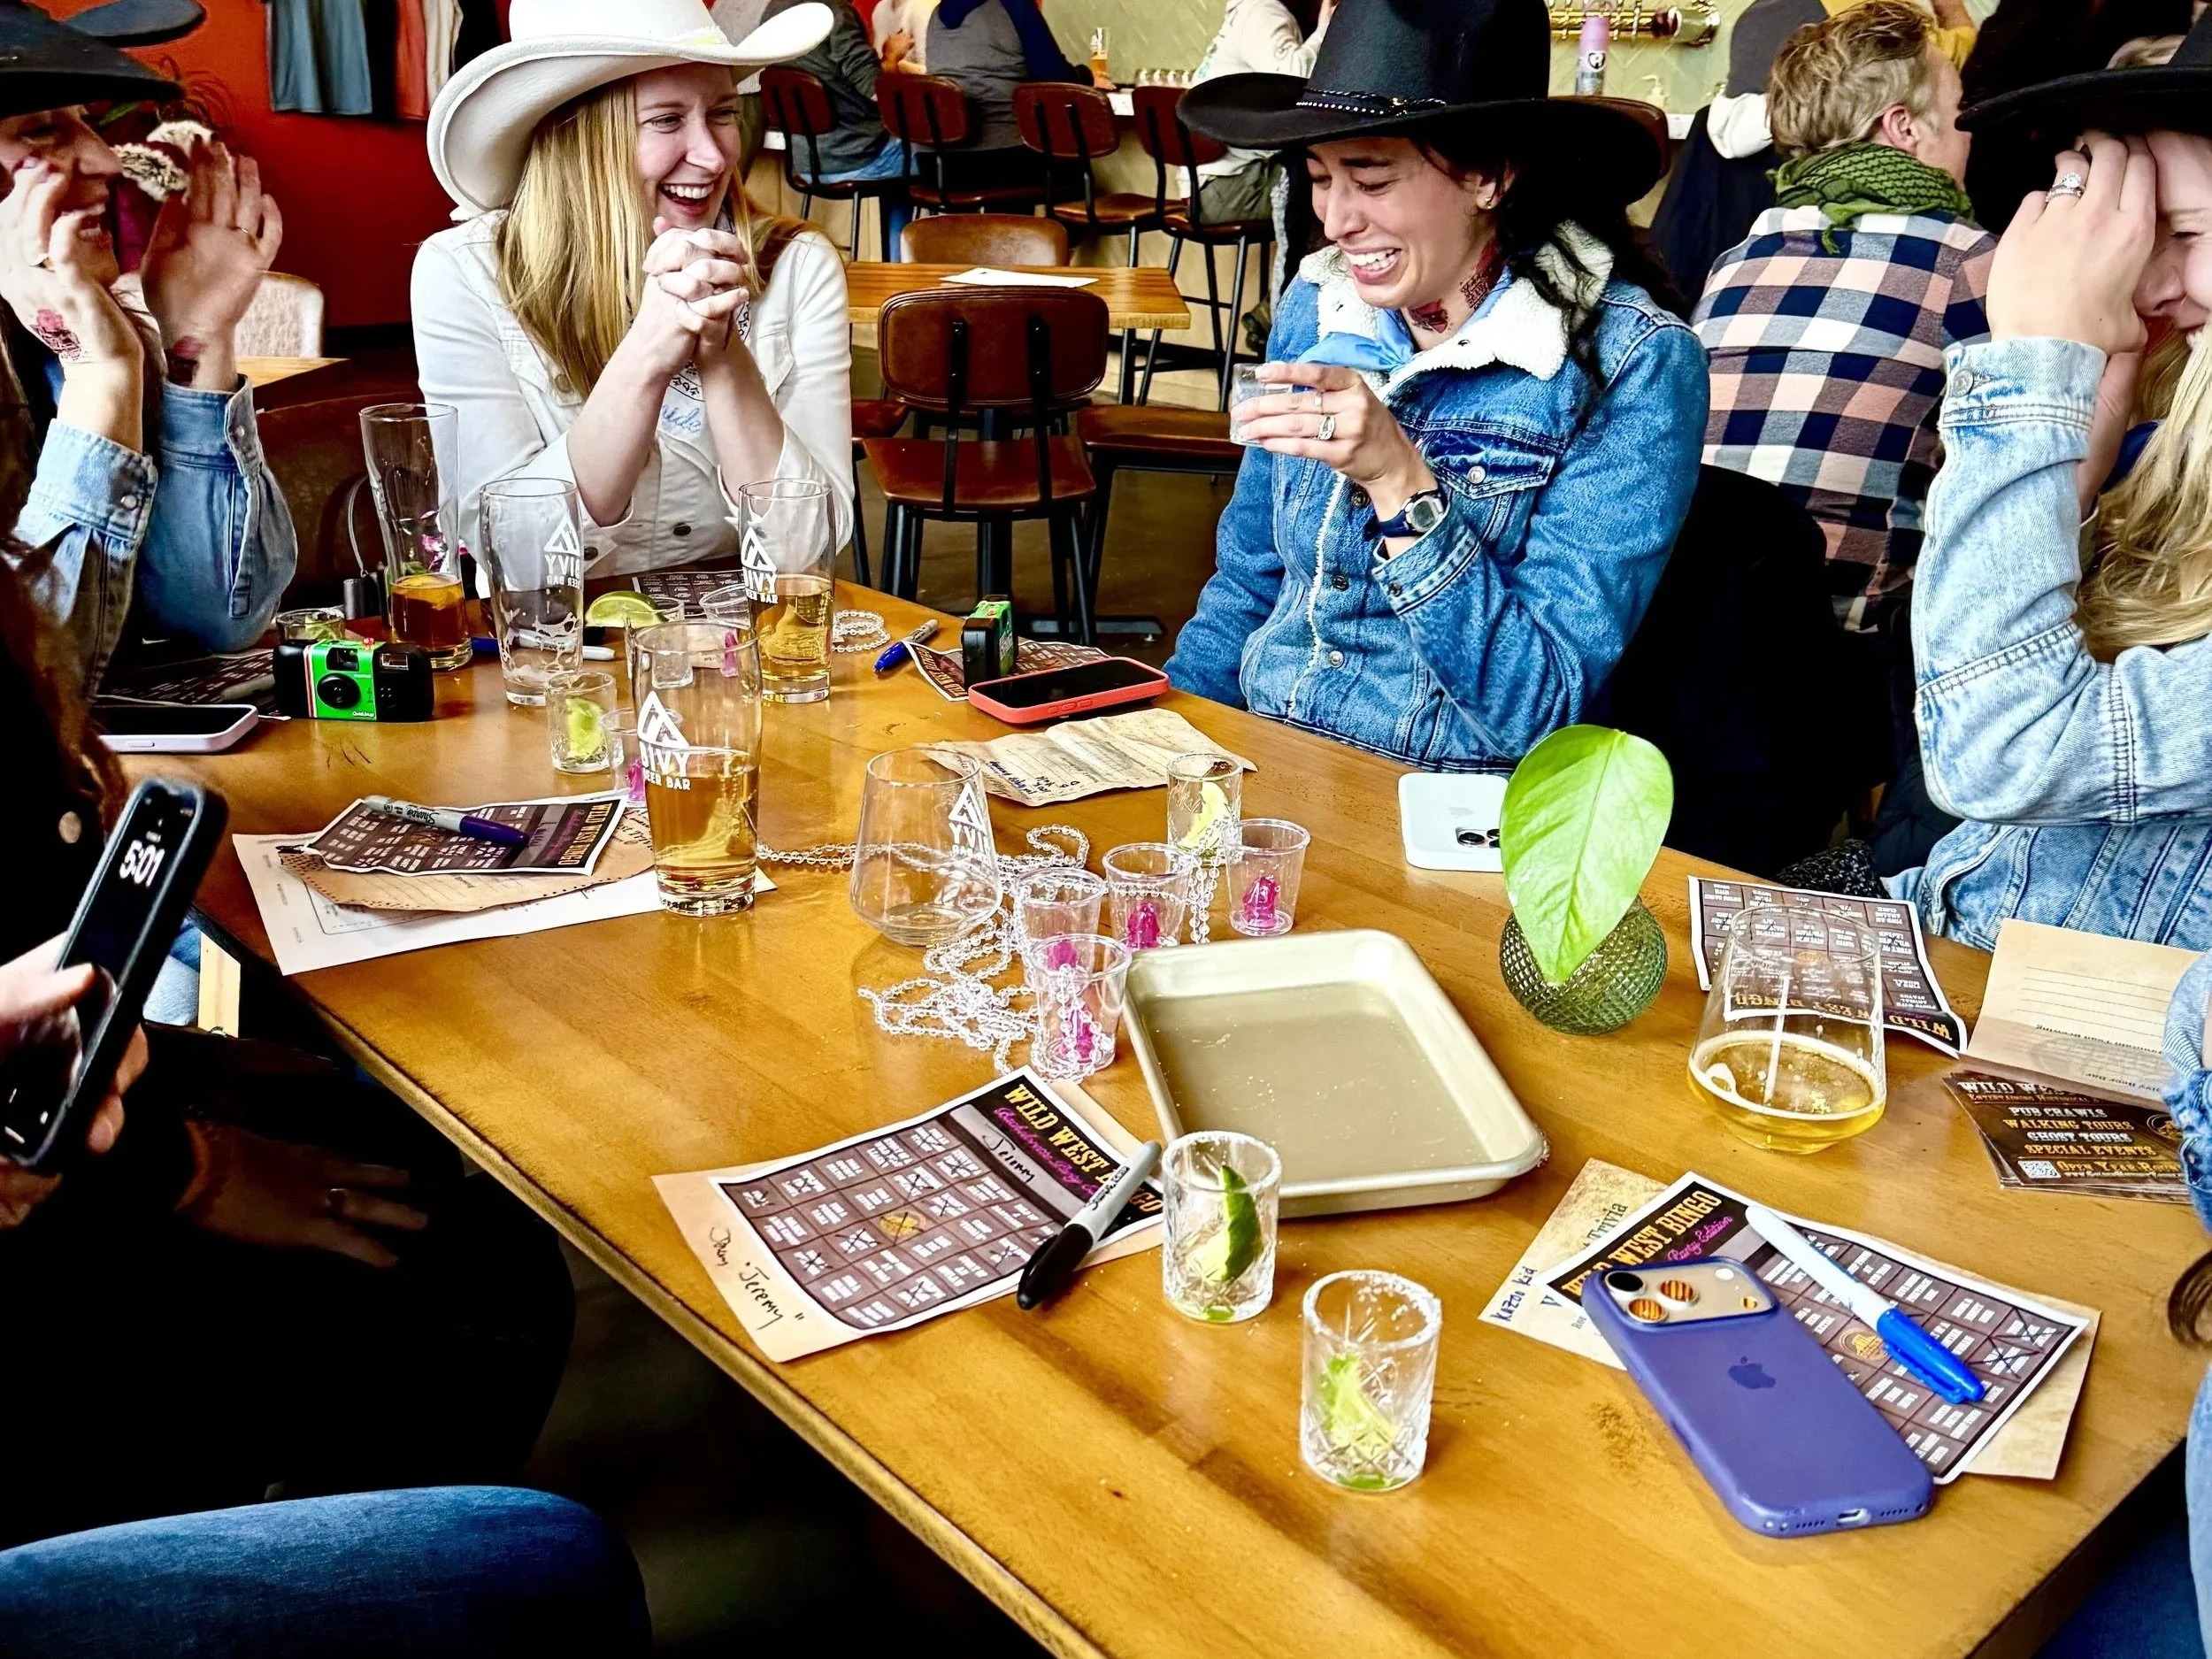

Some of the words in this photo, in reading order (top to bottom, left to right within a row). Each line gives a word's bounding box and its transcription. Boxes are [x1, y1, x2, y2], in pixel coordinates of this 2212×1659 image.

[119, 839, 165, 888] 5:01
[1887, 1013, 1953, 1041] WILD
[1957, 1081, 2015, 1094] WILD
[2003, 1119, 2079, 1130] WALKING
[2081, 1120, 2135, 1131] TOURS
[2008, 1107, 2042, 1118] PUB
[2044, 1107, 2108, 1118] CRAWLS
[1002, 1083, 1062, 1130] WILD
[1048, 1125, 1110, 1173] WEST
[2026, 1132, 2076, 1143] GHOST
[2078, 1133, 2133, 1143] TOURS
[2024, 1144, 2087, 1155] SPECIAL
[2090, 1145, 2157, 1156] EVENTS
[1587, 1202, 1629, 1246] Trivia
[1608, 1225, 1673, 1266] WEST
[1655, 1190, 1723, 1237] BINGO
[1697, 1215, 1733, 1242] Edition
